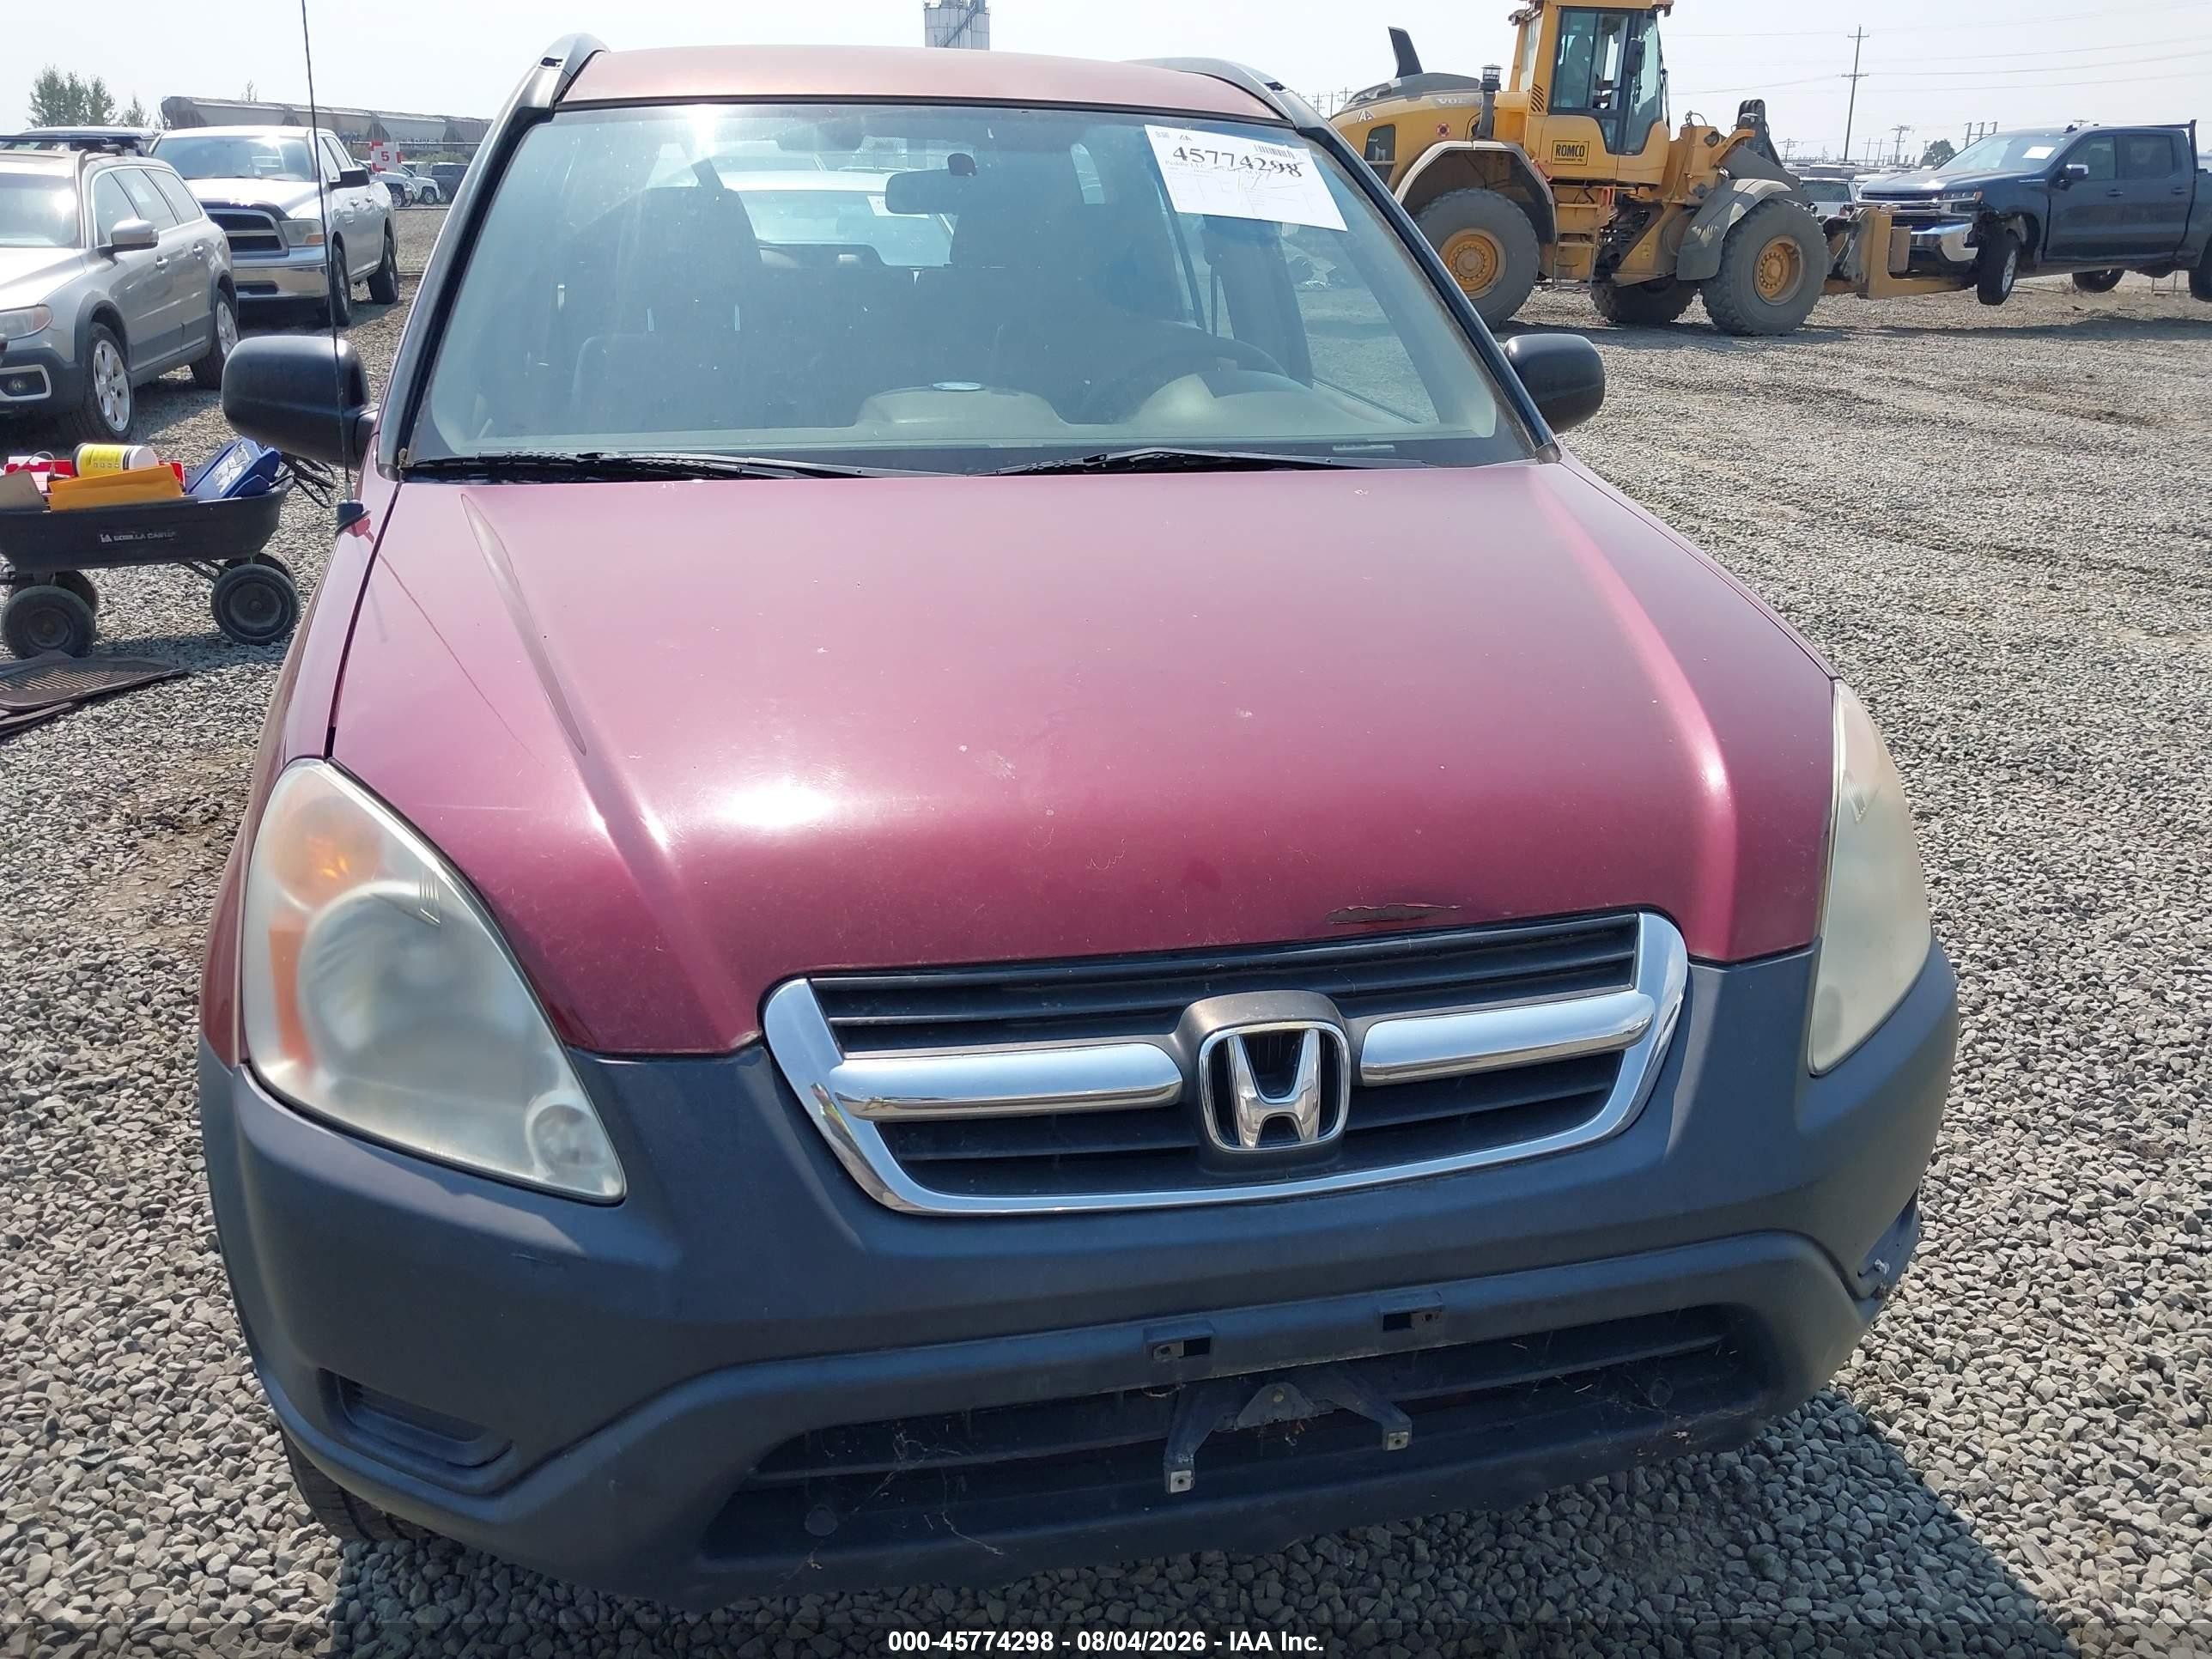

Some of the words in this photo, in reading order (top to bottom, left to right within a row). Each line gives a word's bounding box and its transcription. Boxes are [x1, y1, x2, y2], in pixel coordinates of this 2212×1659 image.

[380, 150, 390, 162] 5
[1555, 144, 1585, 157] ROMCO
[1173, 145, 1303, 178] 45774298
